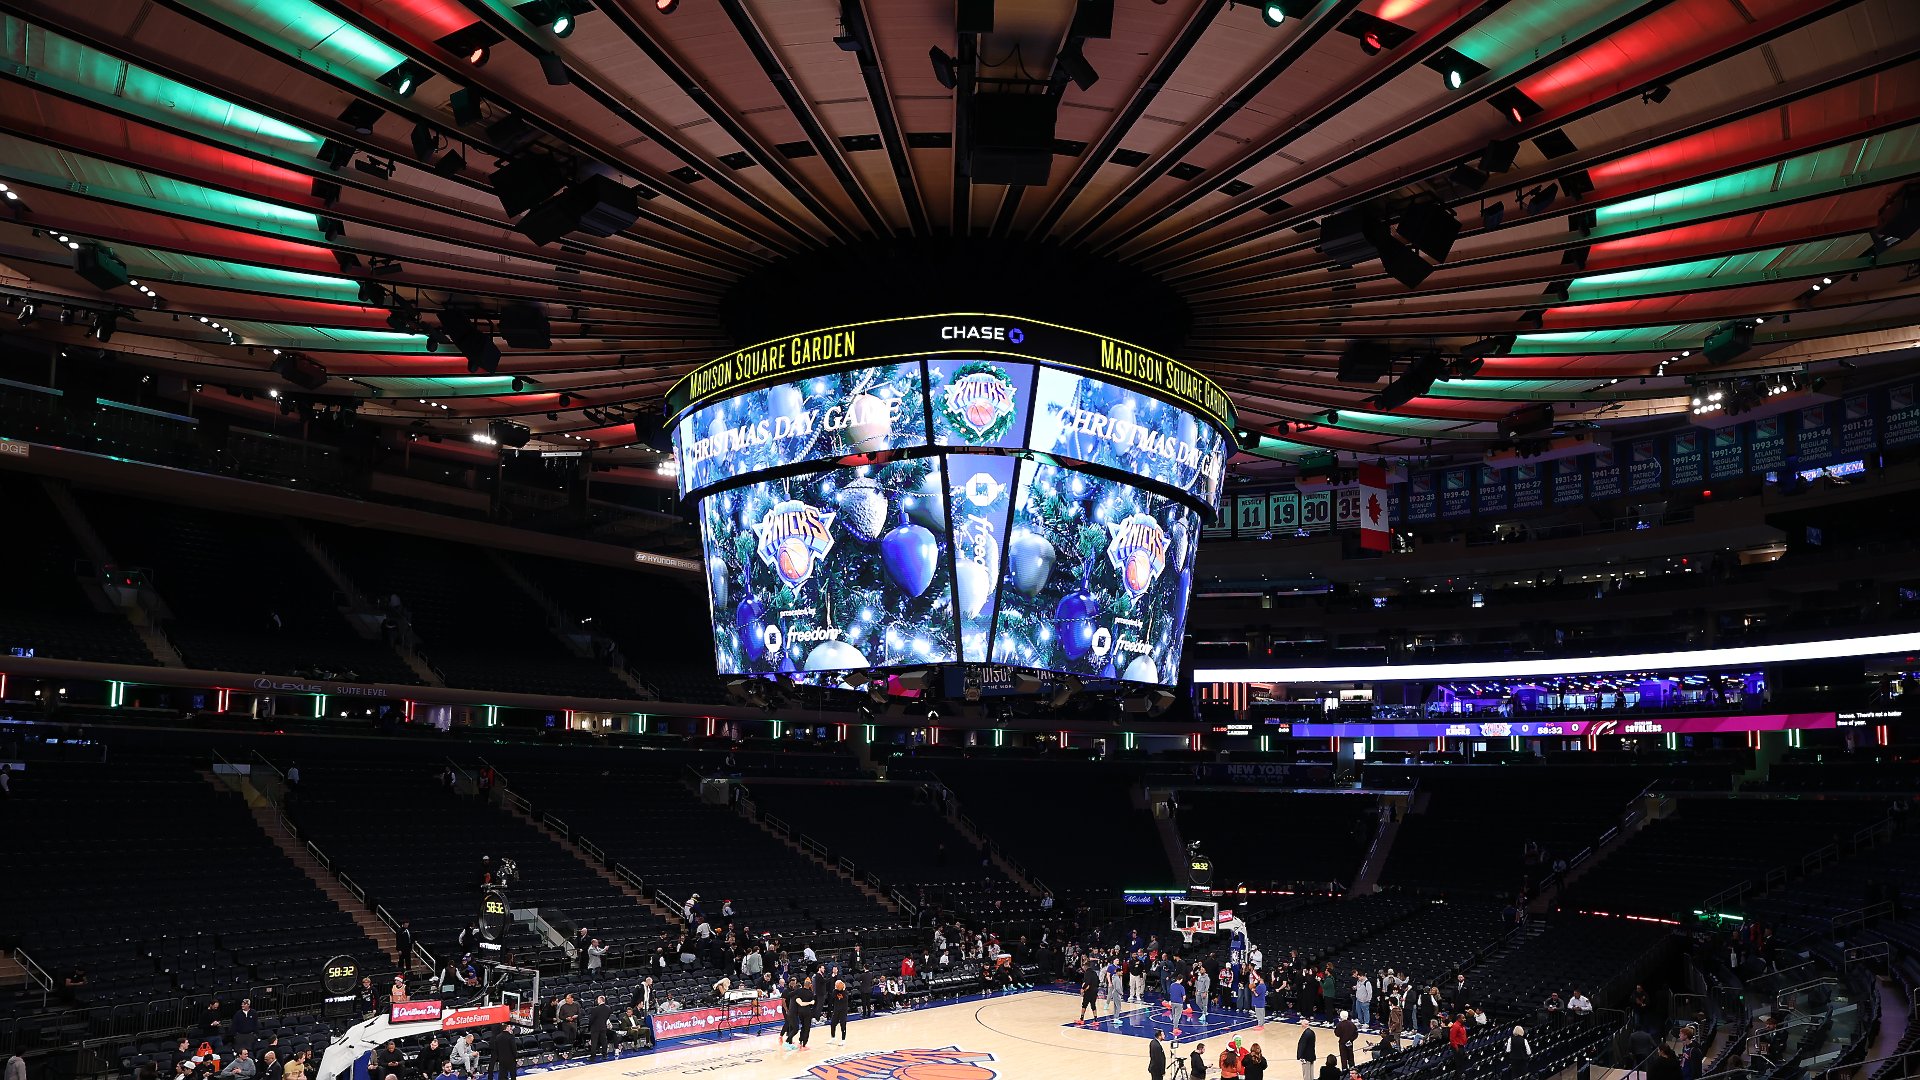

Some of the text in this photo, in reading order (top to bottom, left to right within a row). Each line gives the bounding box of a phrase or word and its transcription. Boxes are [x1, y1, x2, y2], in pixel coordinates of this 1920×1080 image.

[941, 326, 1005, 340] CHASE
[690, 331, 855, 400] MADISON SQUARE GARDEN
[1101, 339, 1229, 421] MADISON SQUARE GARDEN
[956, 379, 1009, 406] KNICKS
[1886, 408, 1919, 424] 2013-14
[1842, 418, 1873, 432] 2011-12
[1889, 420, 1918, 430] EASTERN
[690, 420, 770, 463] CHRISTMAS
[775, 409, 821, 440] DAY
[1056, 406, 1176, 458] CHRISTMAS
[1176, 442, 1203, 469] DAY
[1798, 428, 1832, 441] 1993-94
[1843, 431, 1872, 440] ATLANTIC
[1884, 426, 1920, 438] CONFERENC
[0, 442, 27, 455] DGE
[1752, 438, 1785, 451] 1993-94
[1800, 440, 1829, 449] REGULAR
[1840, 443, 1877, 454] CHAMPIONS
[1845, 438, 1871, 447] DIVISION
[1711, 446, 1742, 458] 1991-92
[1754, 448, 1782, 458] ATLANTIC
[1803, 446, 1827, 456] SEASON
[1672, 454, 1701, 465] 1991-92
[1713, 456, 1740, 465] REGULAR
[1755, 455, 1781, 465] DIVISION
[1798, 452, 1832, 463] CHAMPIONS
[1675, 463, 1698, 472] PATRICK
[1715, 463, 1738, 471] SEASON
[1751, 461, 1786, 472] CHAMPIONS
[1555, 474, 1582, 484] 1931-32
[1675, 470, 1698, 479] DIVISION
[1711, 469, 1744, 479] CHAMPIONS
[1671, 475, 1703, 486] CHAMPIONS
[1591, 489, 1621, 498] CHAMPIONS
[1273, 504, 1295, 524] 19
[1303, 501, 1329, 522] 30
[1339, 498, 1360, 519] 35
[1242, 507, 1261, 527] 11
[764, 508, 821, 541] KNICKS
[1116, 523, 1166, 556] KNICKS
[789, 626, 842, 642] freedom
[272, 682, 388, 697] LEXUS SUITE LEVEL
[1227, 764, 1290, 775] NEW YORK
[329, 966, 354, 979] 58:32
[427, 1004, 441, 1017] Day
[692, 1015, 707, 1027] Day
